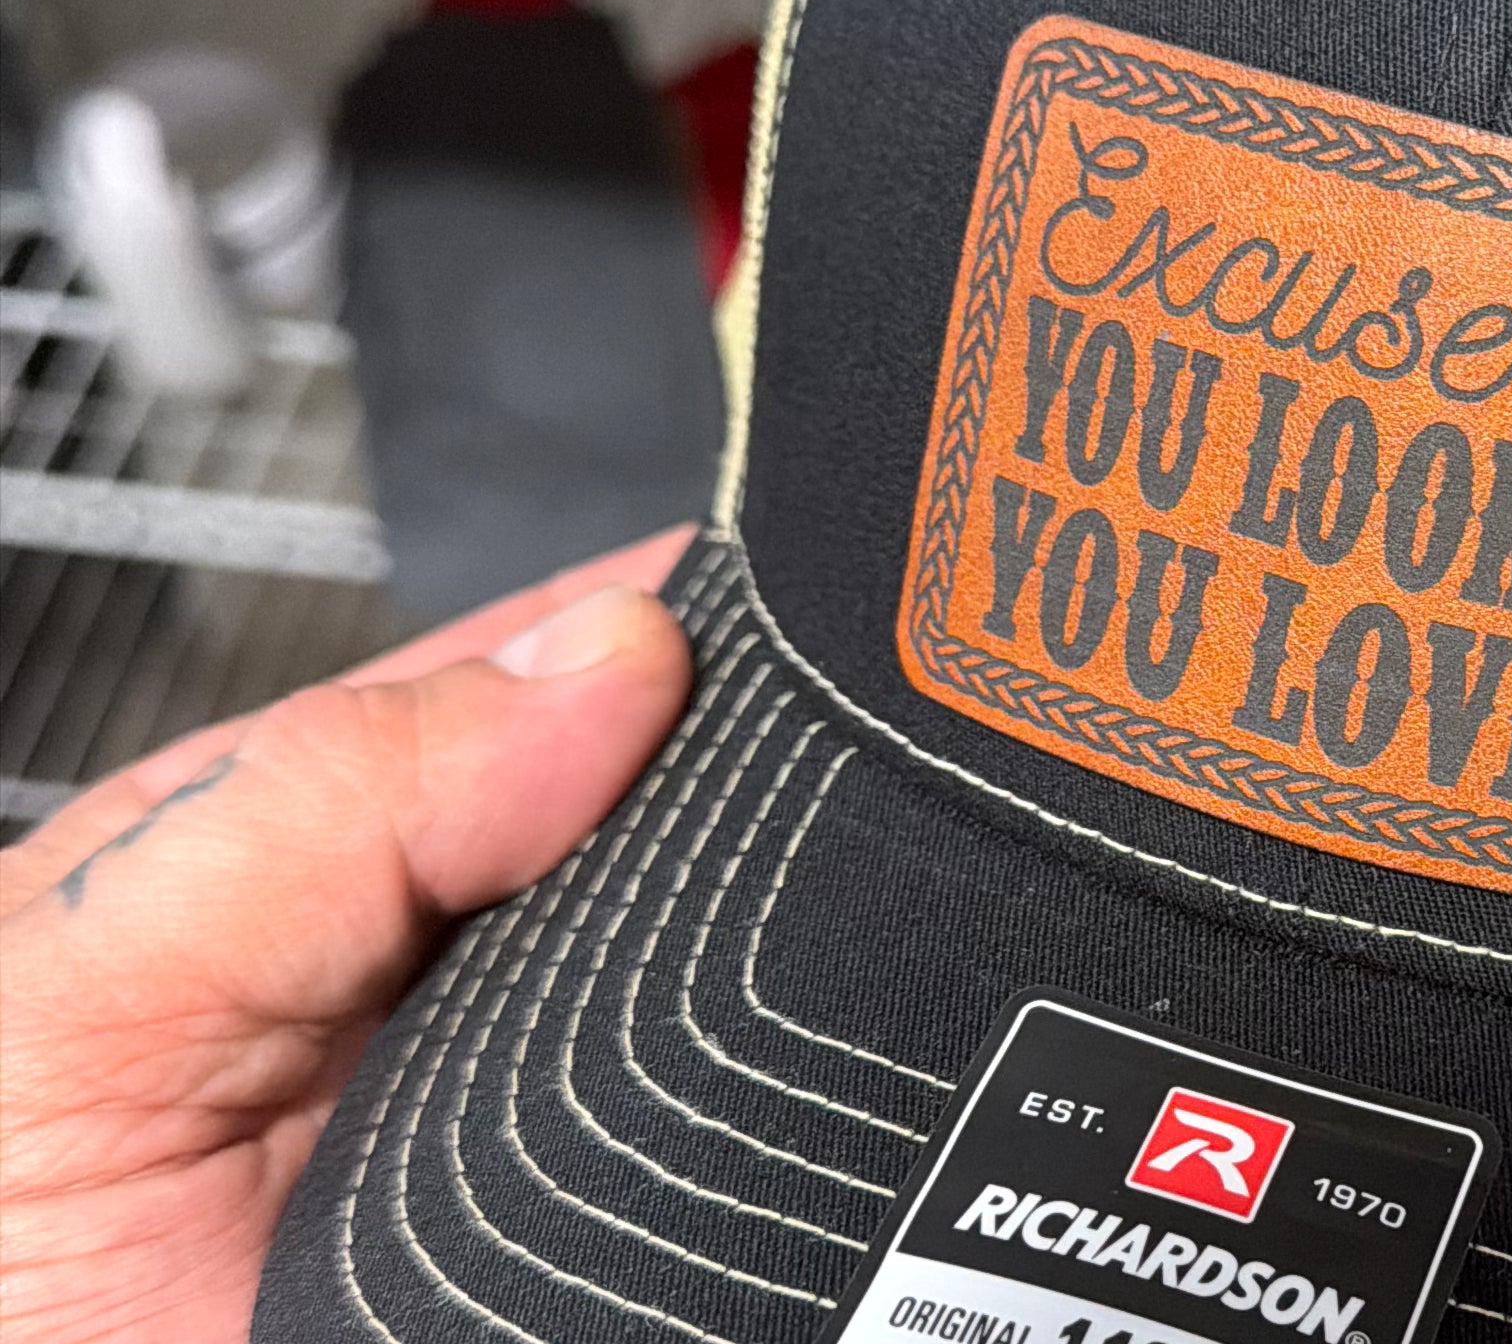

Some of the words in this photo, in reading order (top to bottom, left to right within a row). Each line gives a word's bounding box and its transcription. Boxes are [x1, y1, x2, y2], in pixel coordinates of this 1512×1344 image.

[1015, 297, 1221, 509] YOU
[982, 475, 1219, 699] YOU
[1019, 1092, 1105, 1133] EST.
[1312, 1176, 1407, 1229] 1970
